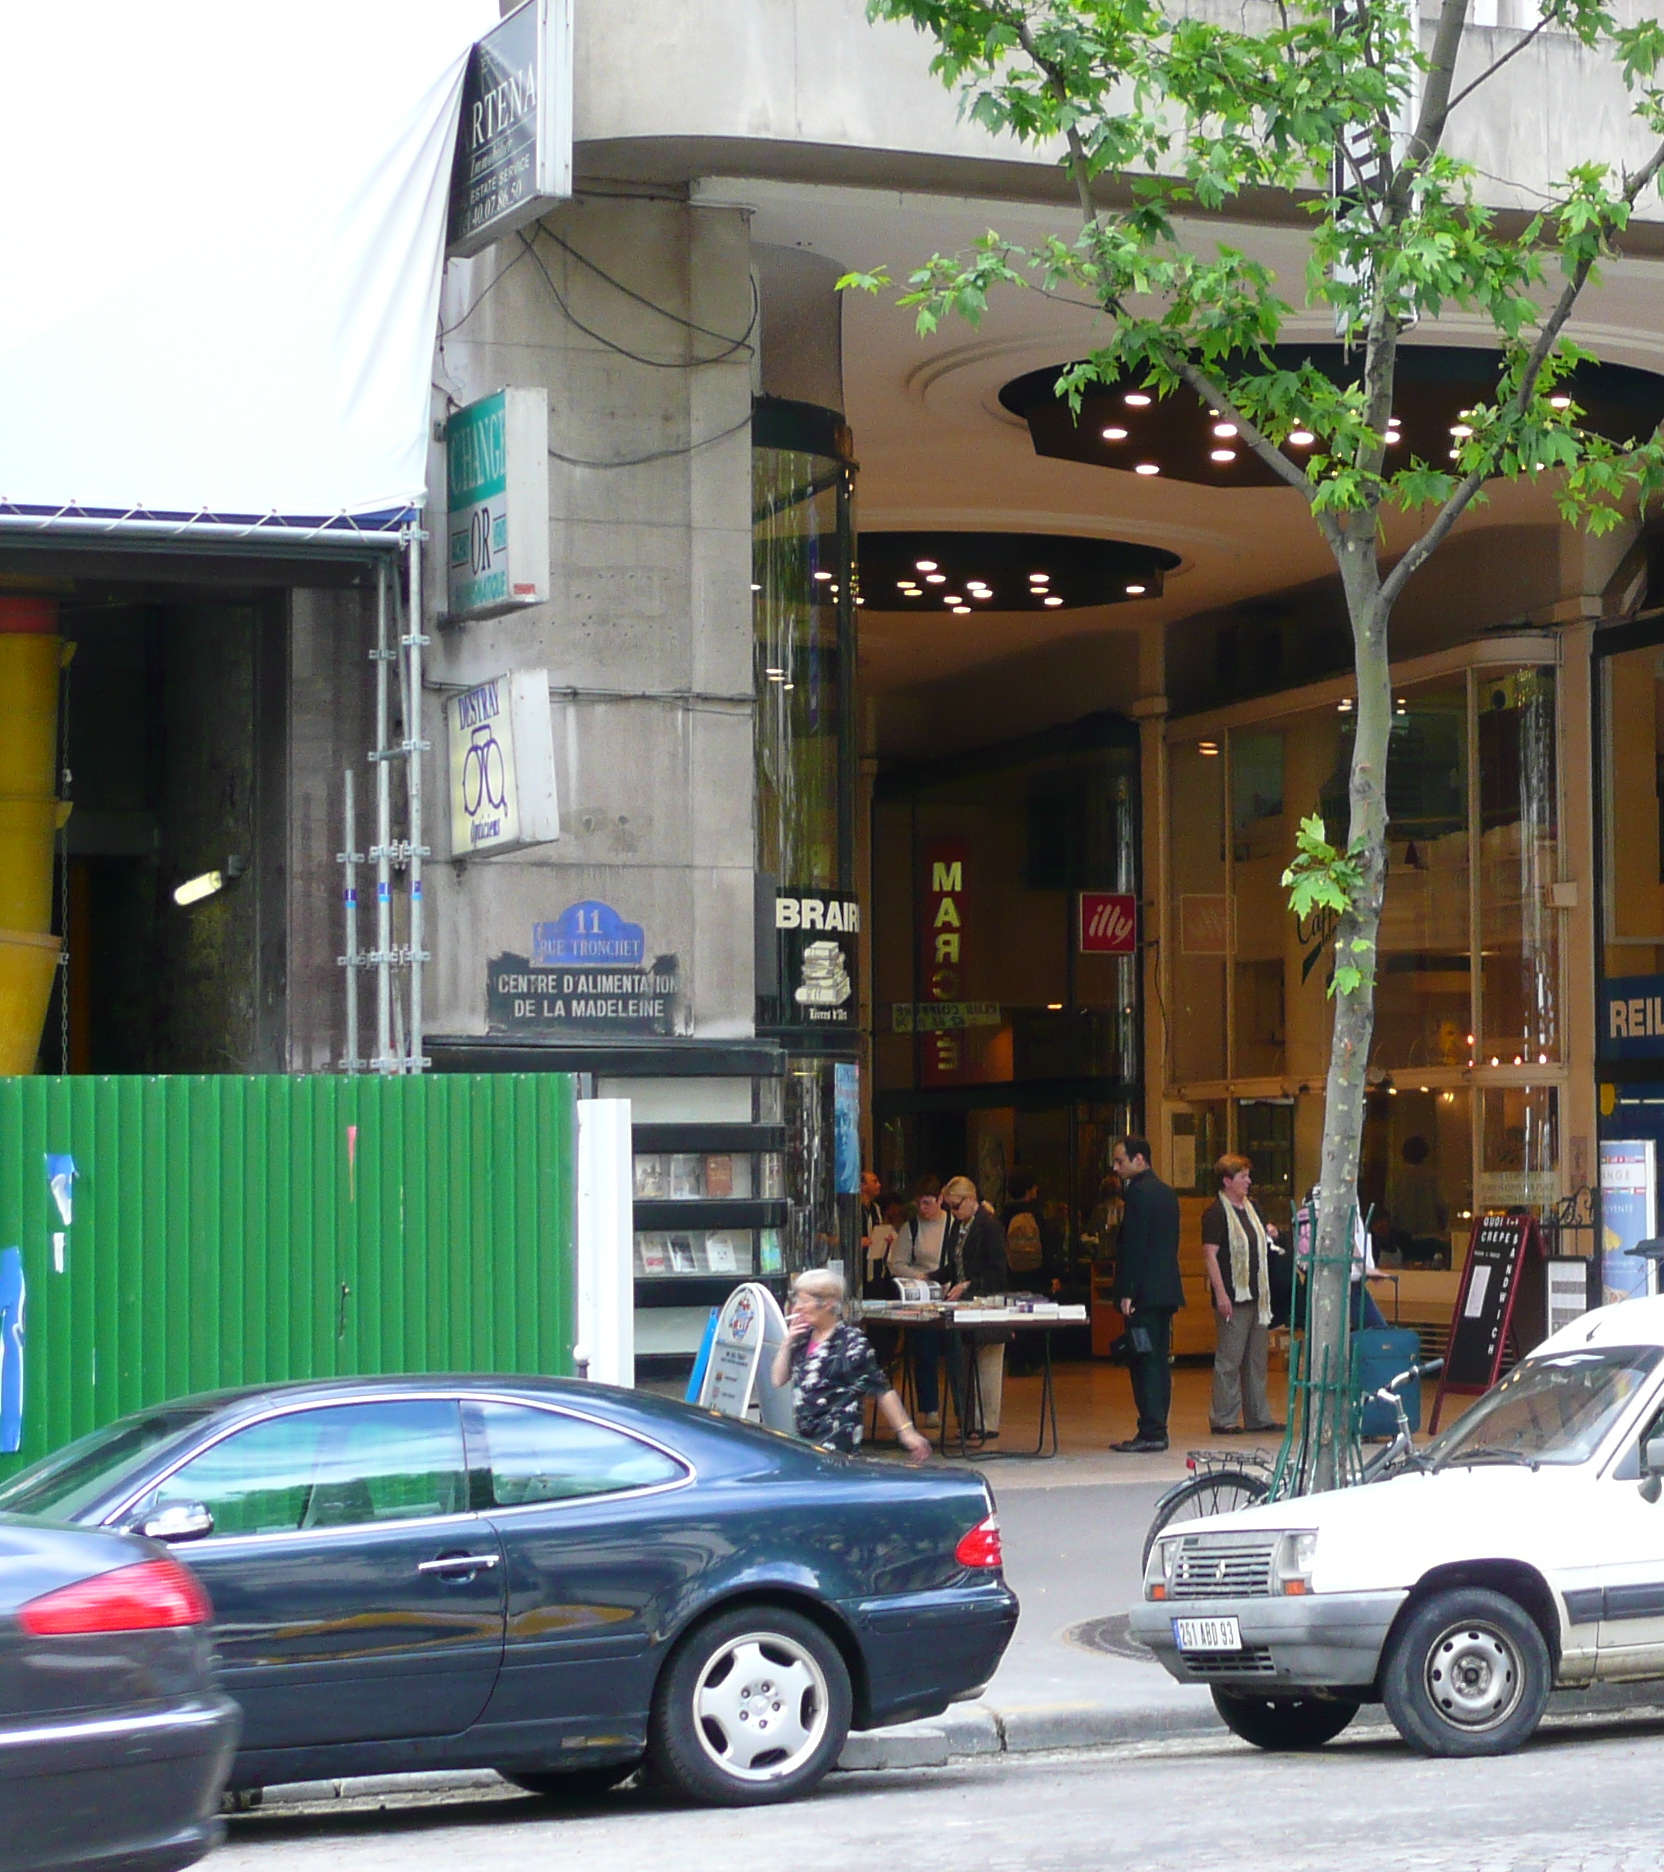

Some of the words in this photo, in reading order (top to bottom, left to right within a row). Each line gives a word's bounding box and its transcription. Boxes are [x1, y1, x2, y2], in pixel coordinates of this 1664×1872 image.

[498, 153, 531, 186] SERVICE
[471, 507, 491, 576] OR
[575, 909, 603, 934] 11
[1088, 903, 1133, 946] illy
[541, 940, 565, 956] RUE
[572, 940, 641, 956] TRONCHET
[498, 974, 558, 994] CENTRE
[563, 974, 680, 994] D'ALIMENTAION
[514, 1000, 536, 1017] DE
[543, 1000, 566, 1017] LA
[571, 1000, 665, 1017] MADELEINE
[1180, 1622, 1198, 1647] 251
[1220, 1620, 1234, 1646] 93
